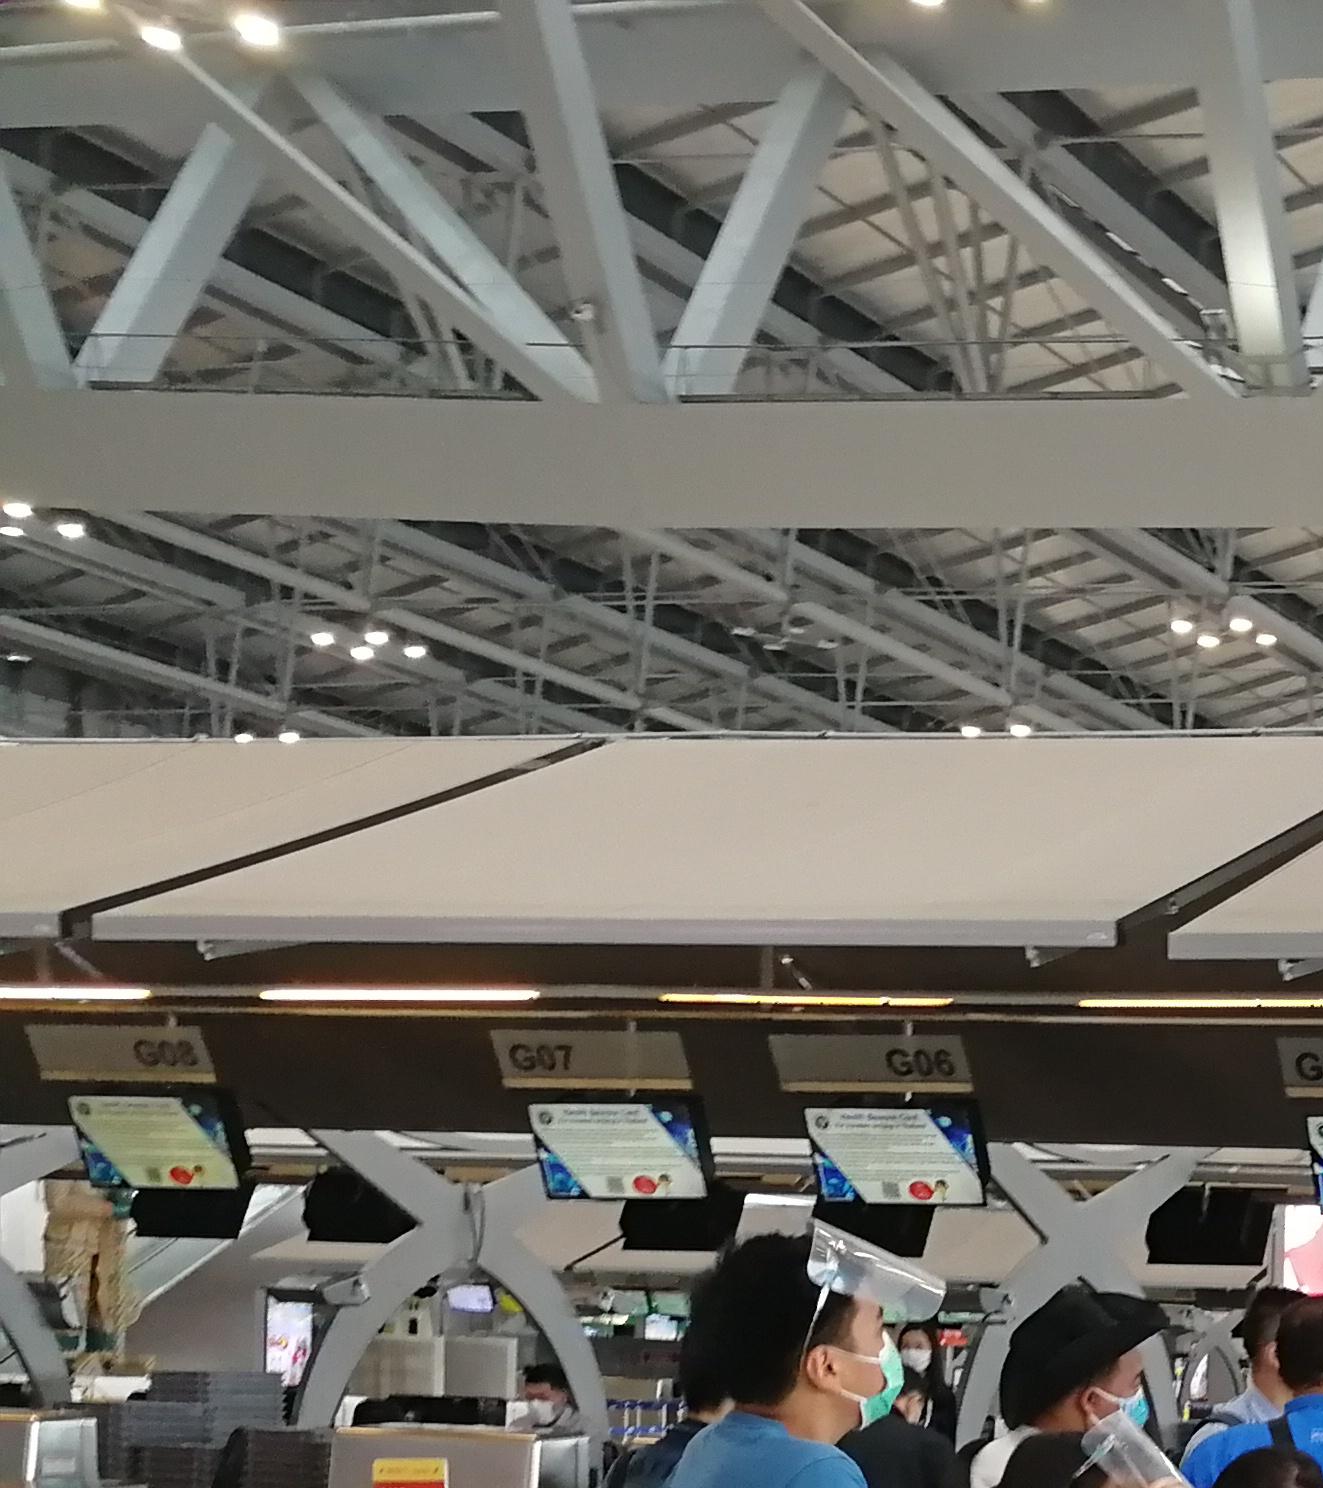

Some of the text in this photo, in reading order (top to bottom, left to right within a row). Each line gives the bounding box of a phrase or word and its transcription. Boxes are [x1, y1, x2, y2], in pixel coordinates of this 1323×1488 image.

[133, 1040, 200, 1068] G08
[509, 1044, 574, 1072] G07
[885, 1048, 955, 1077] G06
